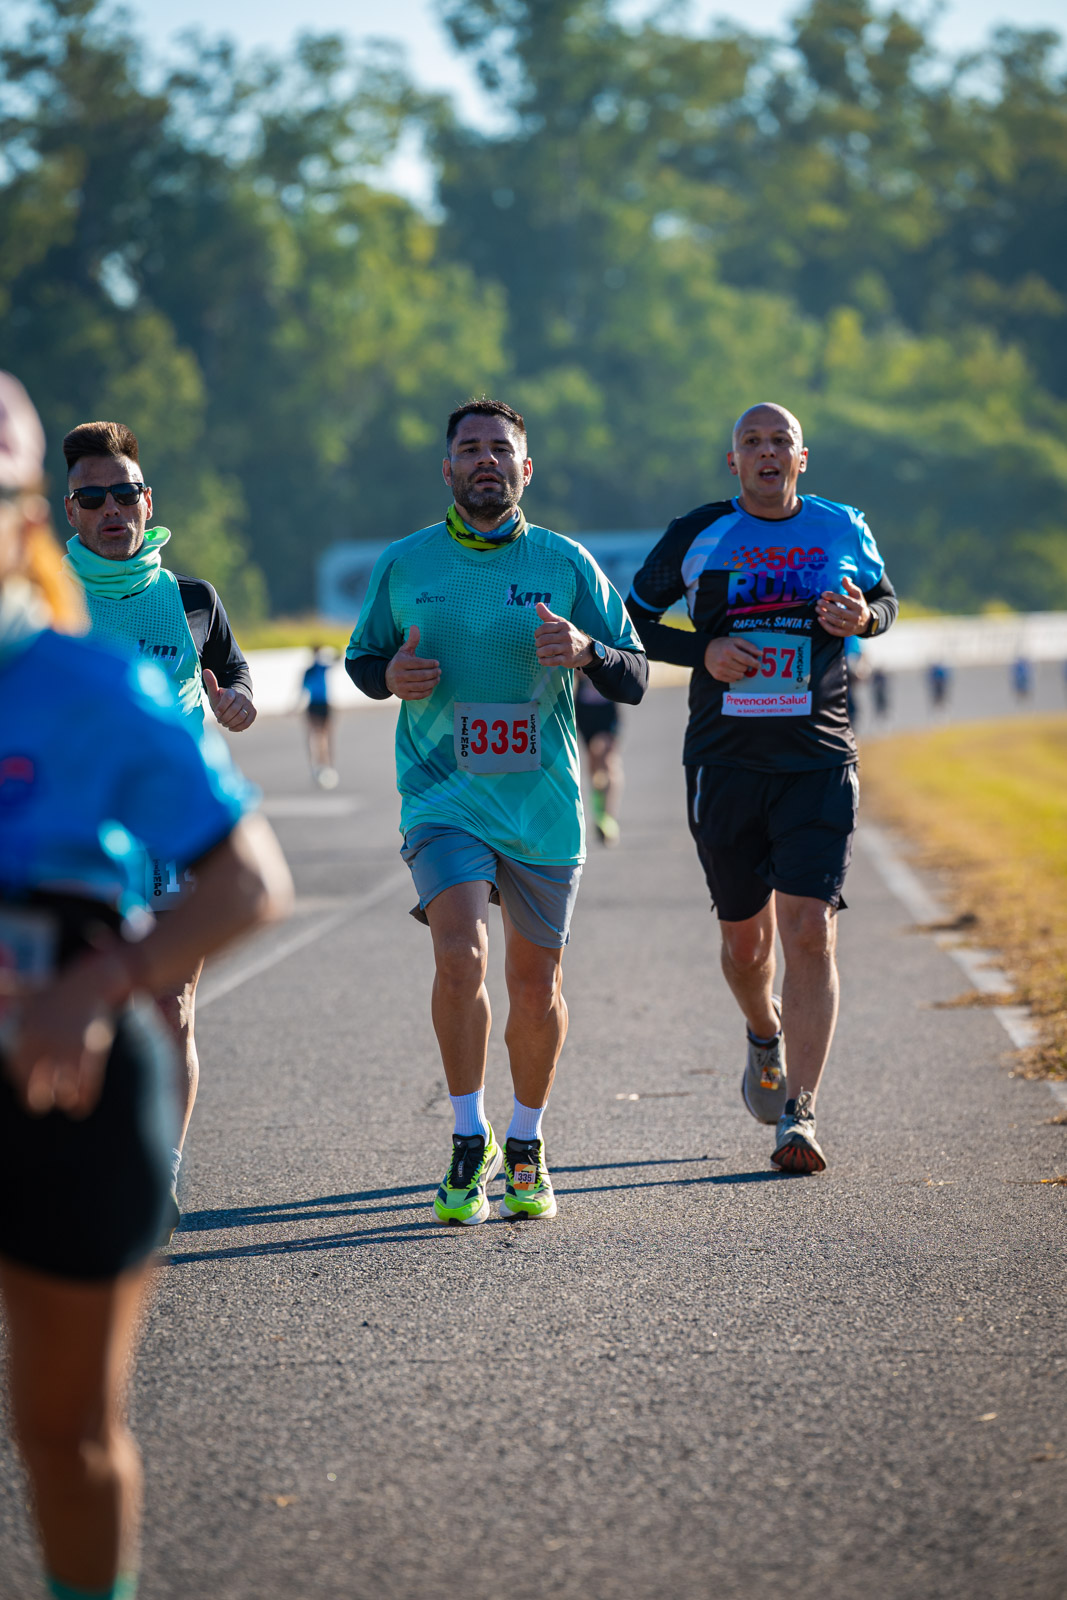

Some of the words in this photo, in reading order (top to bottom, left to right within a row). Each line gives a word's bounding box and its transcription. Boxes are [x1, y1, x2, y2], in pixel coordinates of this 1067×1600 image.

[765, 547, 825, 570] 500
[416, 596, 446, 604] INVICTO
[506, 584, 552, 606] km
[774, 616, 803, 629] SANTA
[796, 646, 804, 683] EXACTO
[726, 694, 777, 706] Prevención
[779, 694, 807, 705] Salud
[461, 716, 469, 757] TIEMPO
[470, 719, 529, 755] 335
[518, 1172, 532, 1182] 335
